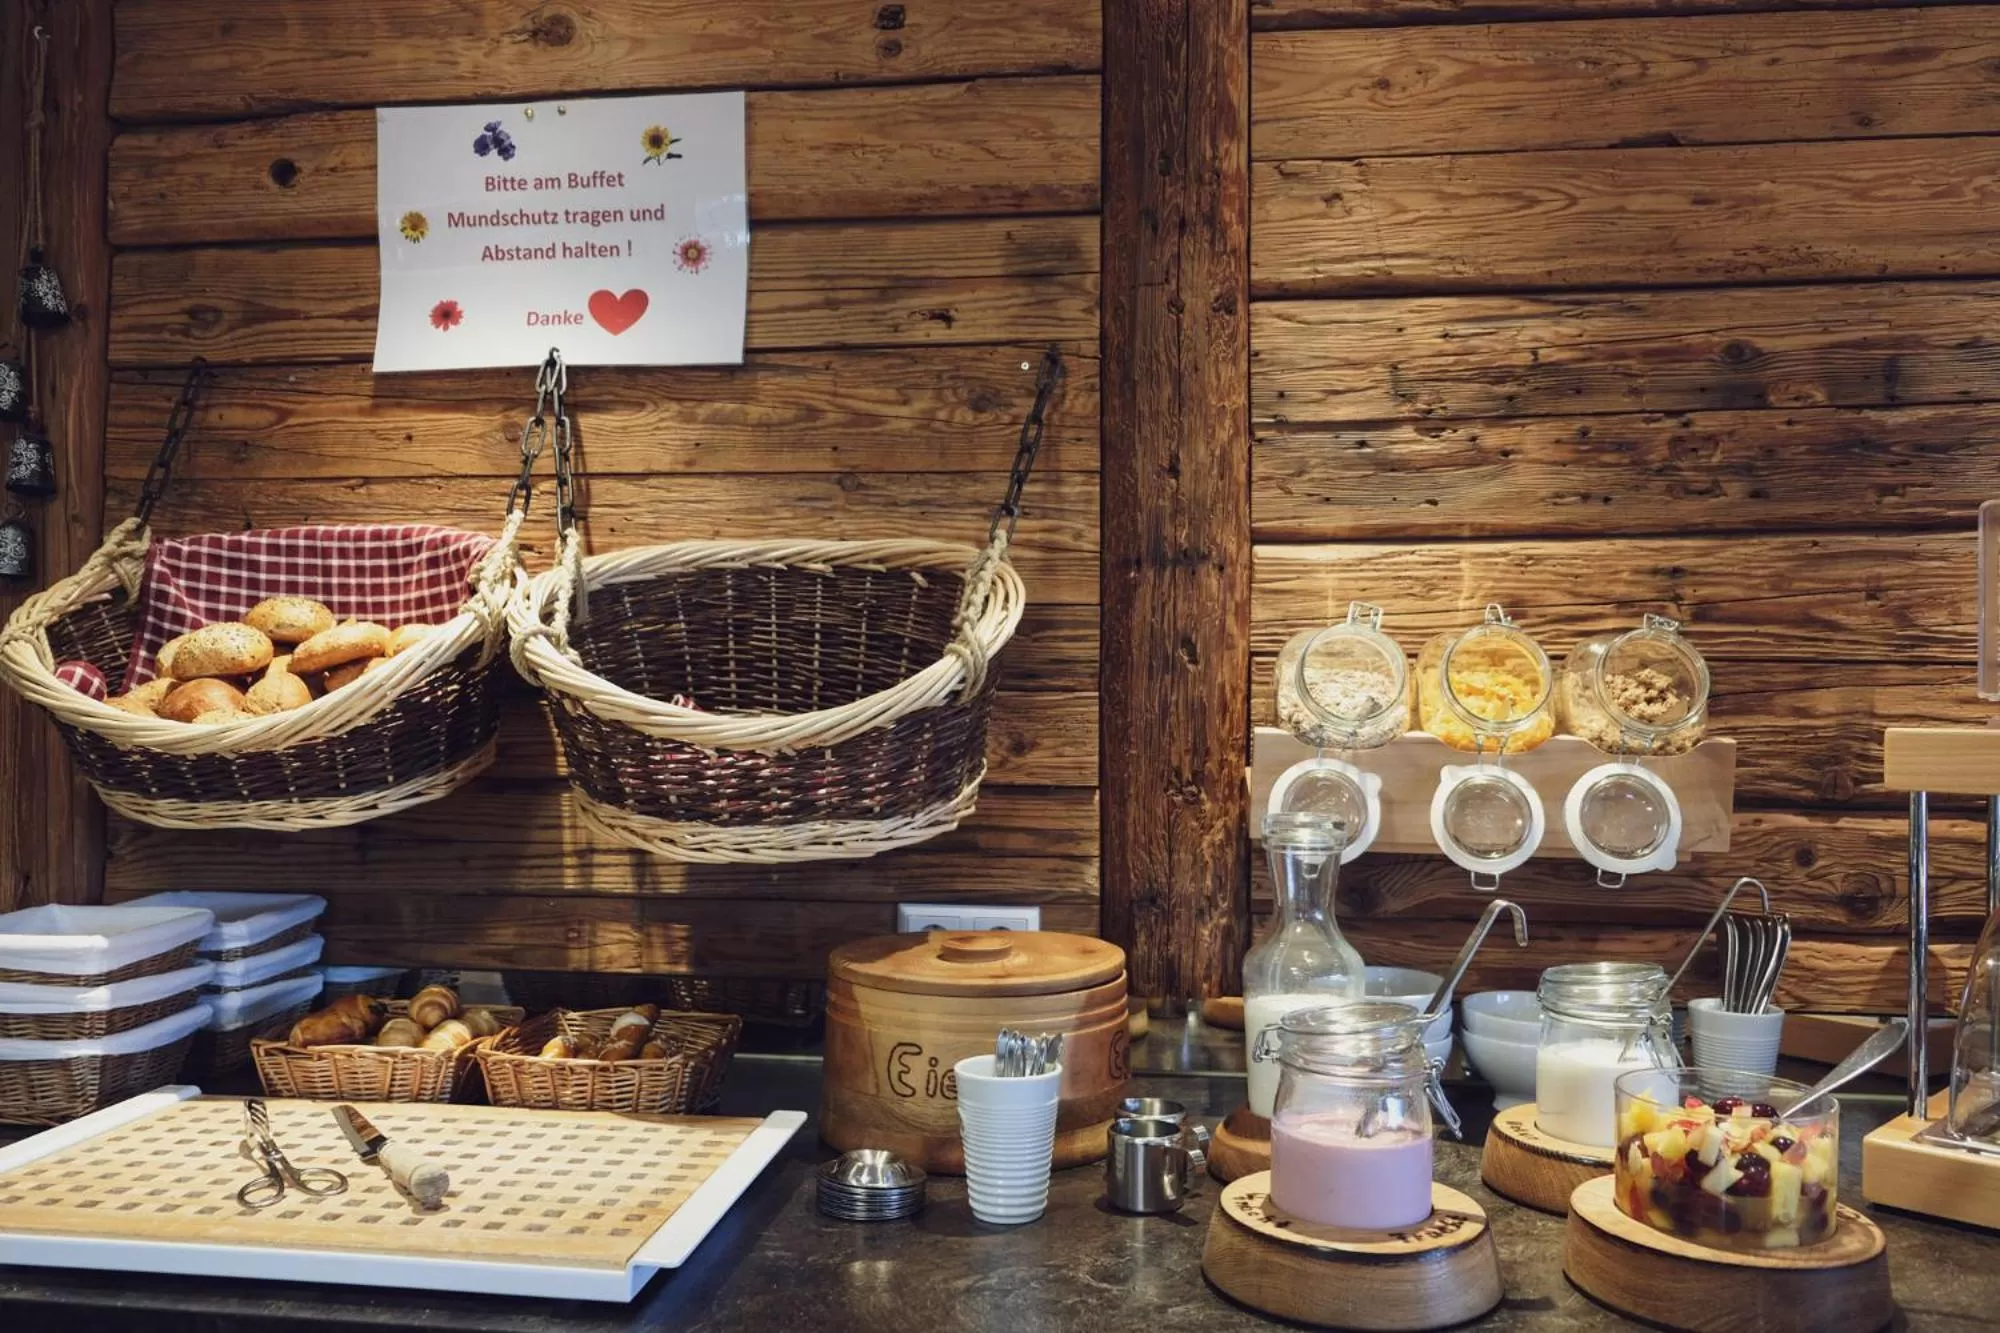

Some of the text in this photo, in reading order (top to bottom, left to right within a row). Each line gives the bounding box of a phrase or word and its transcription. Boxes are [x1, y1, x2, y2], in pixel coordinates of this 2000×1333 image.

[485, 171, 625, 191] Bitte am Buffet
[448, 204, 665, 228] Mundschutz tragen und
[481, 240, 632, 261] Abstand halten !
[527, 310, 584, 326] Danke
[887, 1041, 958, 1100] Eie
